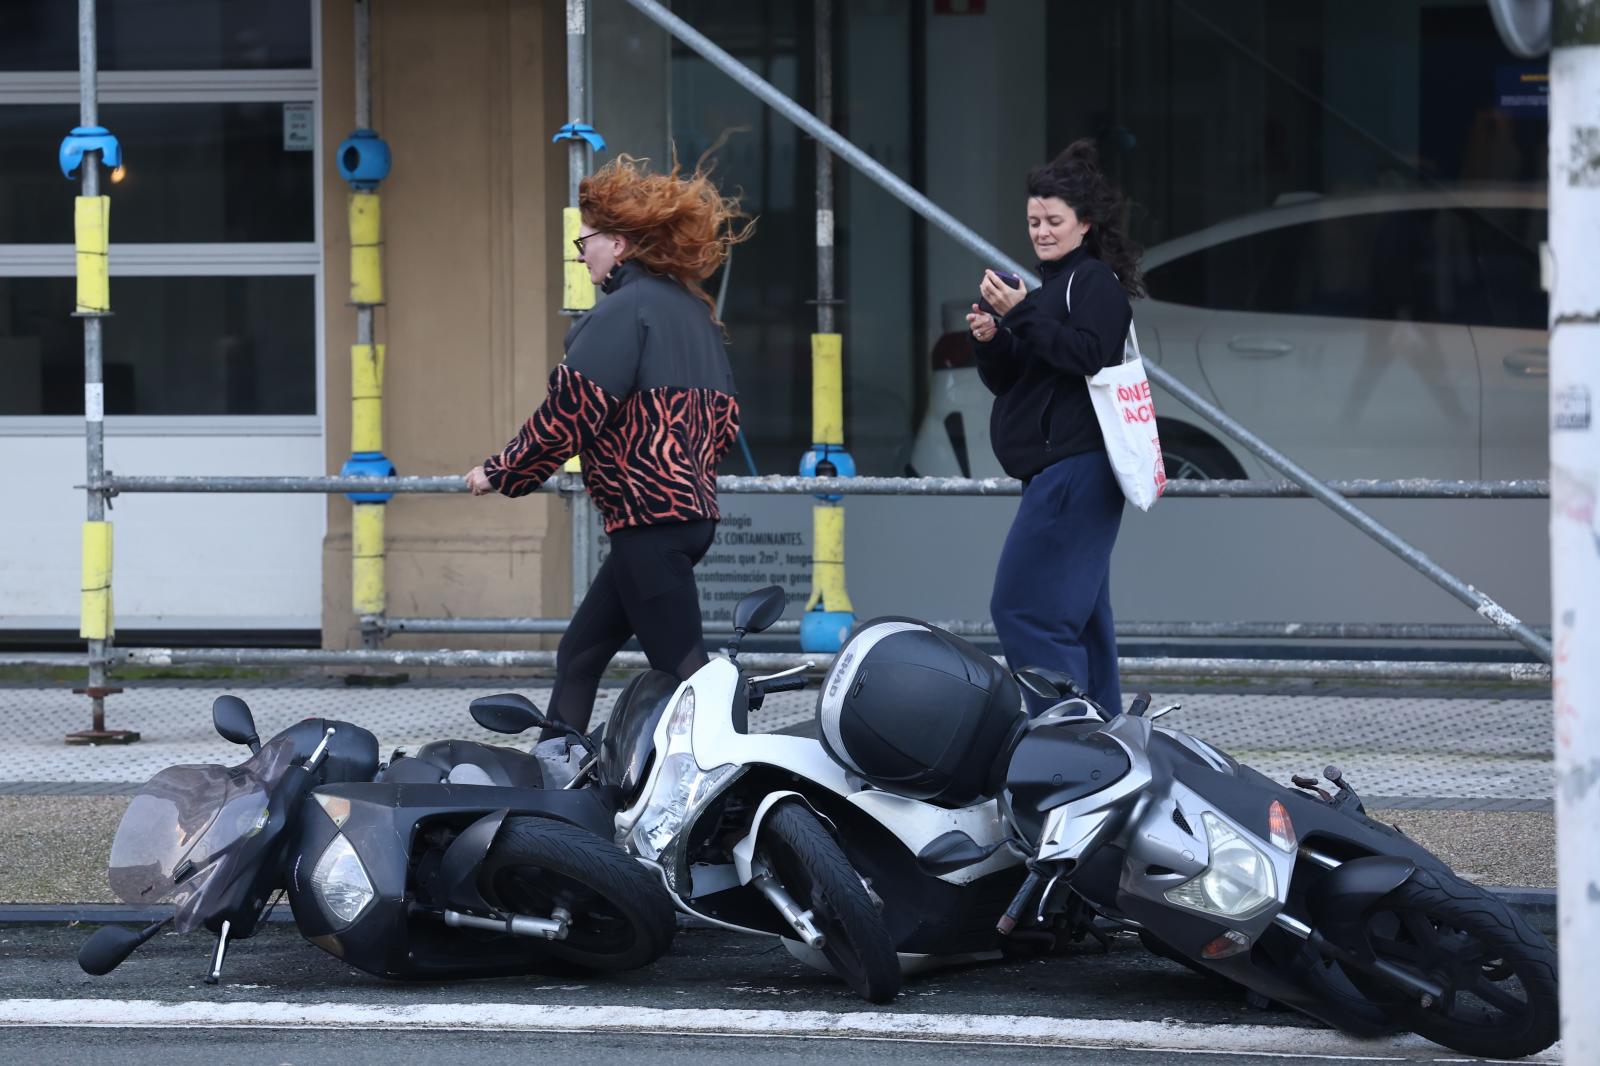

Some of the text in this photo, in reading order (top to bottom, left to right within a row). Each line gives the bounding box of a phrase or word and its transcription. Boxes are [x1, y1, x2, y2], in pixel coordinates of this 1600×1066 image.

[724, 531, 805, 546] CONTAMINANTES.
[738, 555, 756, 567] que
[829, 652, 854, 698] SHAD
